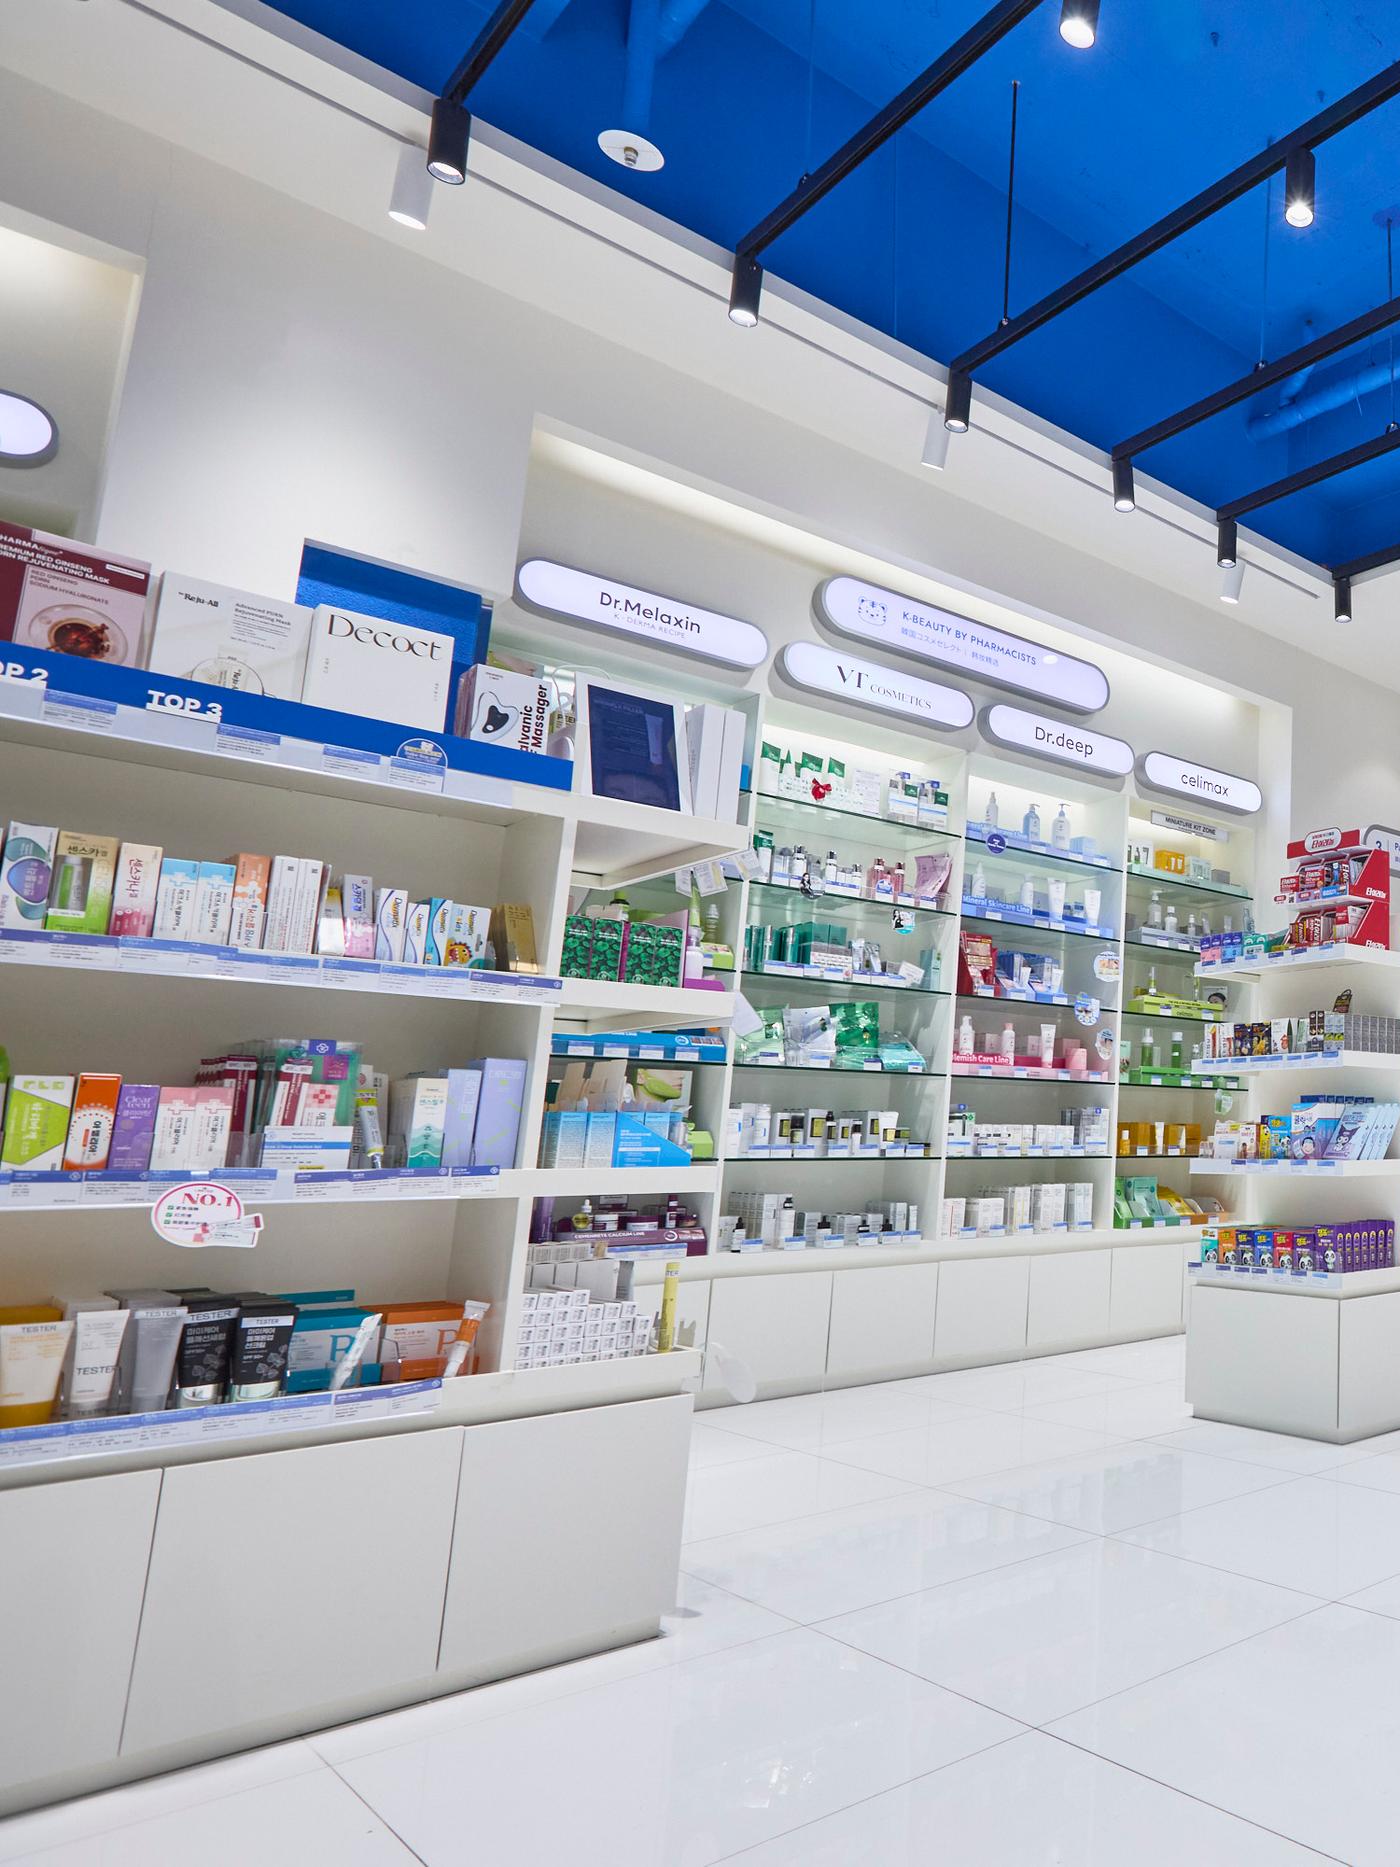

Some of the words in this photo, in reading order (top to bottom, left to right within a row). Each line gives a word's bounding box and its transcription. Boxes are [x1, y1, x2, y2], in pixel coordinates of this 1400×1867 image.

[18, 554, 84, 577] REJUVENATING
[85, 572, 110, 584] MASK
[36, 553, 53, 562] RED
[55, 558, 93, 573] GINSENG
[599, 591, 701, 634] Dr.Melaxin
[327, 614, 443, 661] Decoct
[955, 629, 968, 641] BY
[970, 635, 1037, 665] PHARMACISTS
[836, 664, 869, 690] VT
[870, 683, 932, 710] COSMETICS
[148, 689, 201, 713] TOP
[206, 702, 223, 717] 3
[519, 705, 533, 752] alvanic
[531, 685, 548, 748] Massager
[1035, 726, 1094, 758] Dr.deep
[1181, 772, 1230, 797] celimax
[1193, 824, 1202, 832] KIT
[1202, 827, 1216, 835] ZONE
[962, 895, 988, 907] Mineral
[988, 899, 1015, 911] Skincare
[1016, 904, 1032, 914] Line
[953, 1052, 976, 1064] lemish
[977, 1054, 992, 1064] Care
[993, 1055, 1011, 1065] Line
[125, 1095, 152, 1104] Clear
[182, 1193, 233, 1207] NO.1
[190, 1310, 232, 1321] TESTER
[21, 1325, 57, 1333] TESTER
